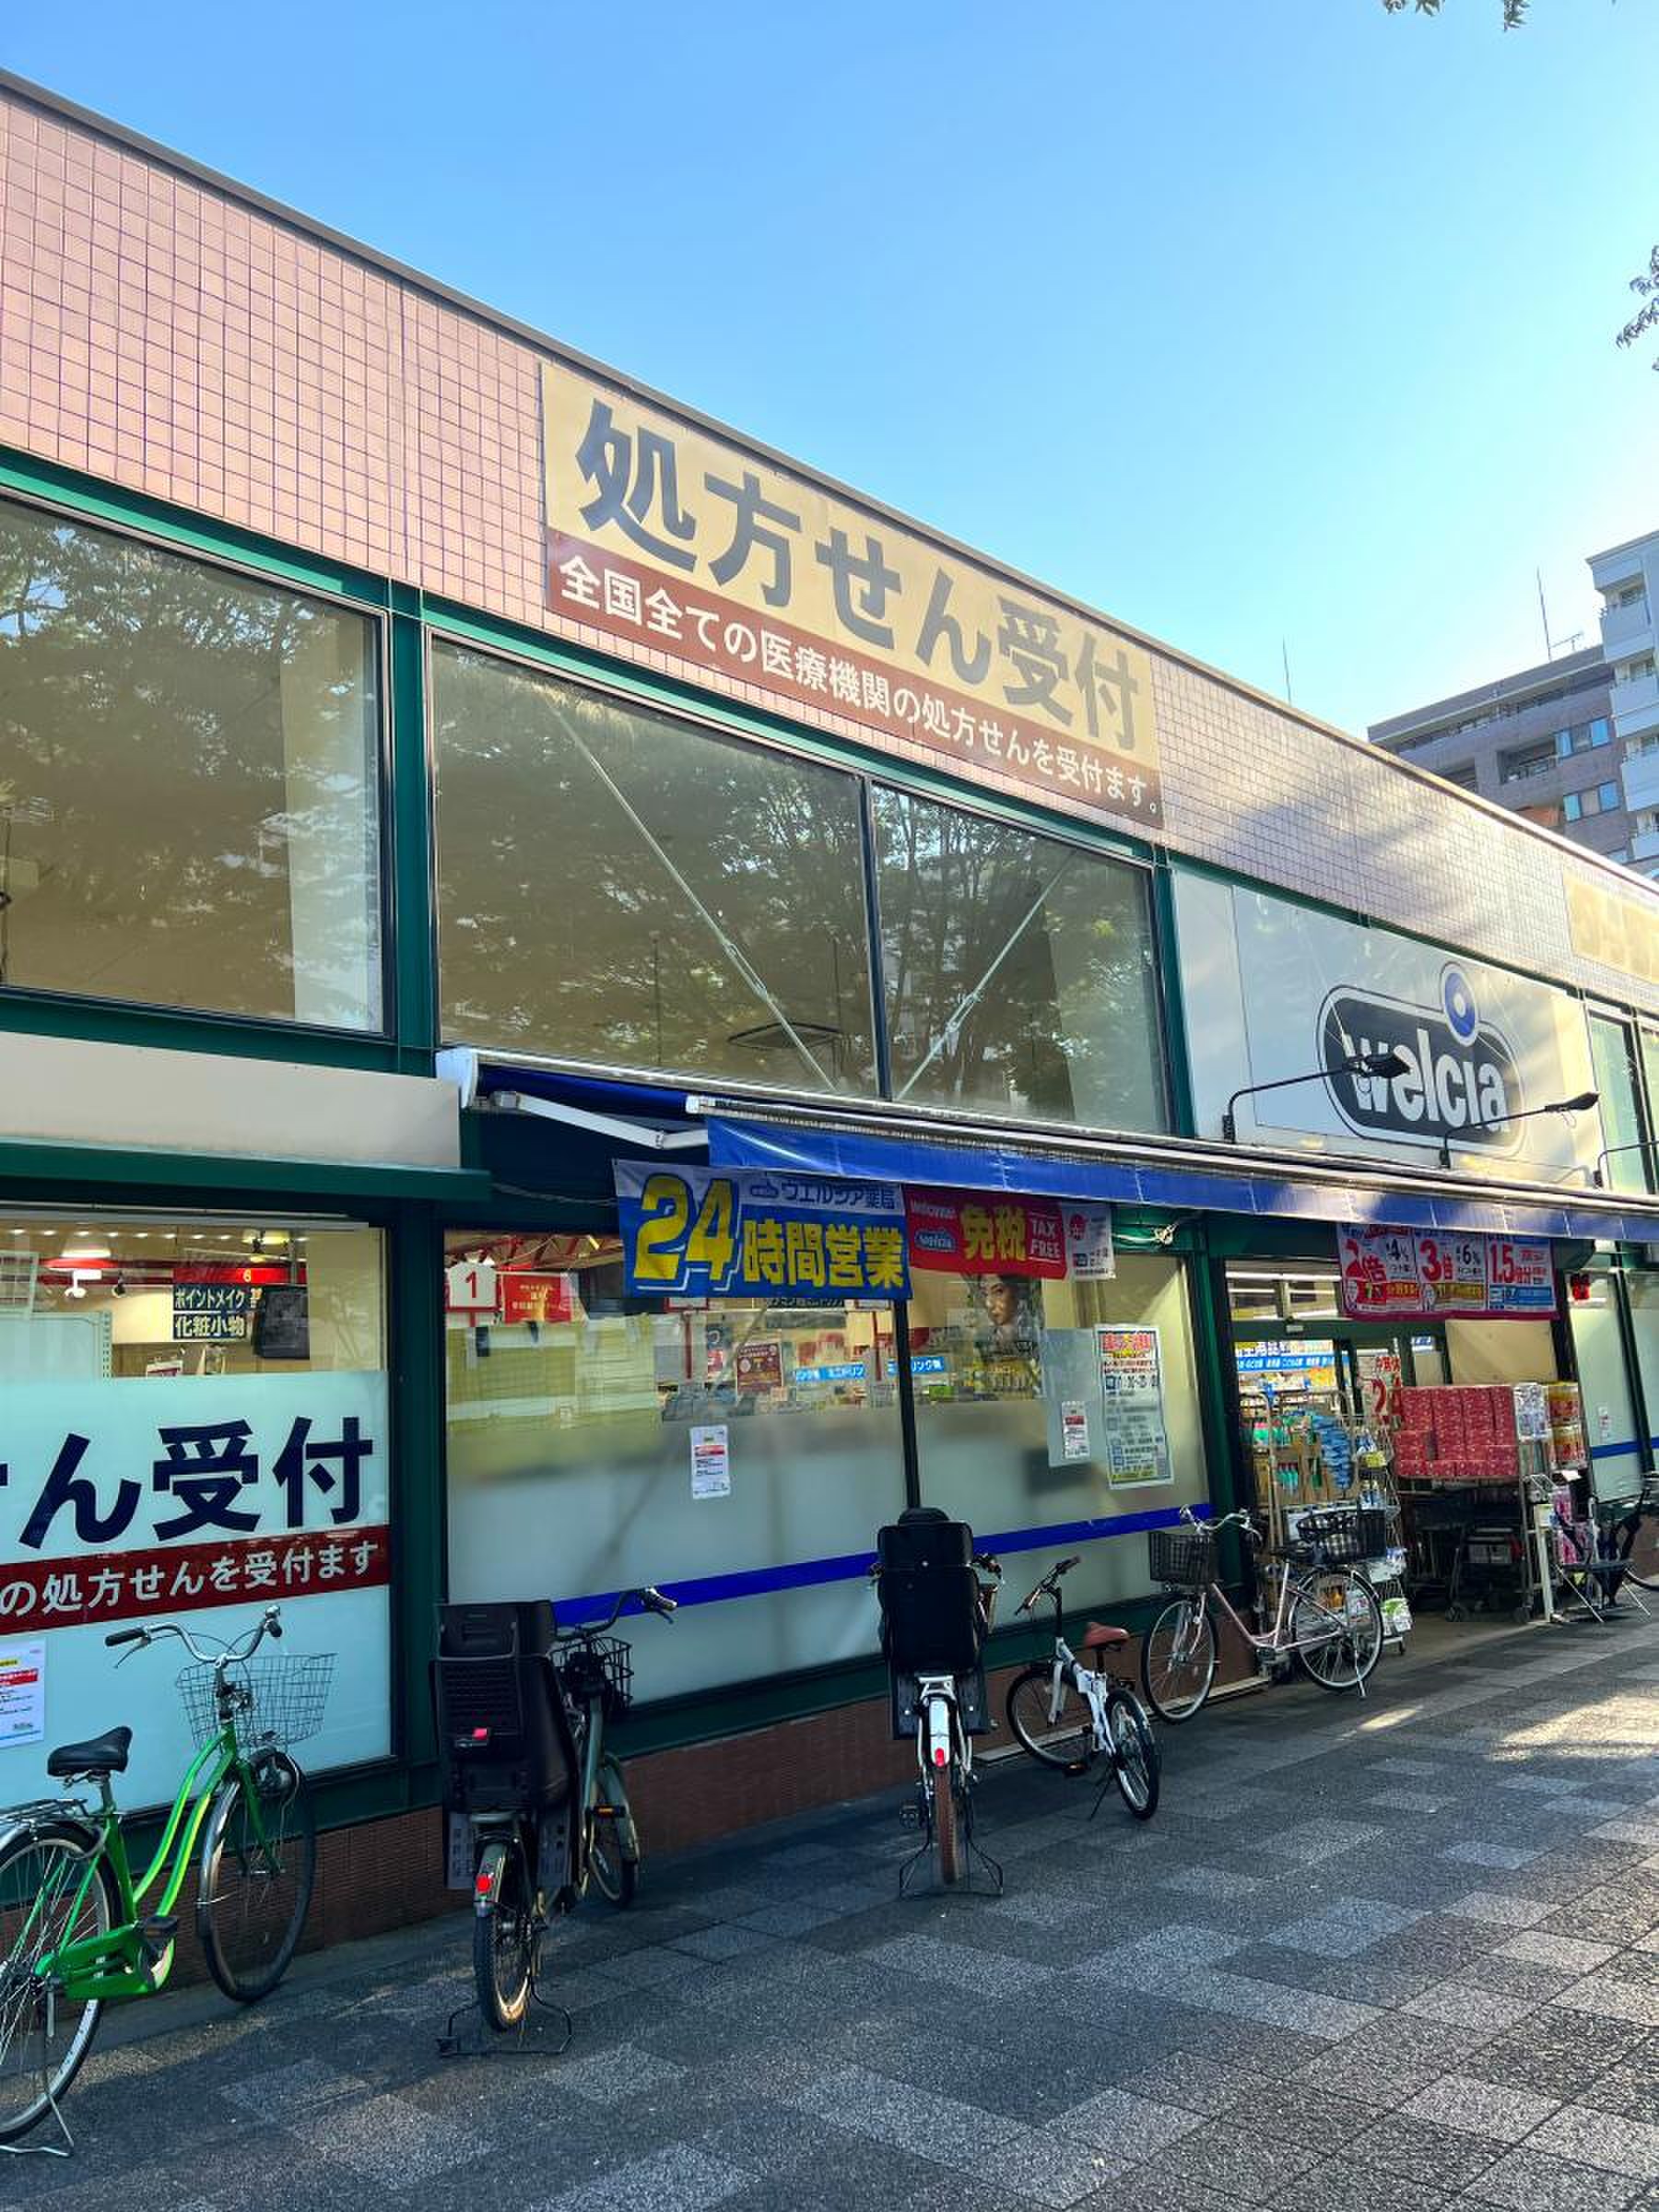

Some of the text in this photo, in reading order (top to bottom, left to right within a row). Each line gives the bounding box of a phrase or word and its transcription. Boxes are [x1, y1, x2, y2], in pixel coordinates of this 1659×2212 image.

[574, 397, 1139, 750] 処方せん受付
[559, 555, 1158, 814] 全国全ての医療機関の処方せんを受付ます。
[962, 1204, 1028, 1262] 免税
[1030, 1218, 1056, 1238] TAX
[1030, 1241, 1061, 1259] FREE
[465, 1271, 477, 1299] 1
[175, 1315, 246, 1338] 化粧小物
[0, 1416, 373, 1549] ん受付
[0, 1540, 379, 1617] の処方せんを受付ます
